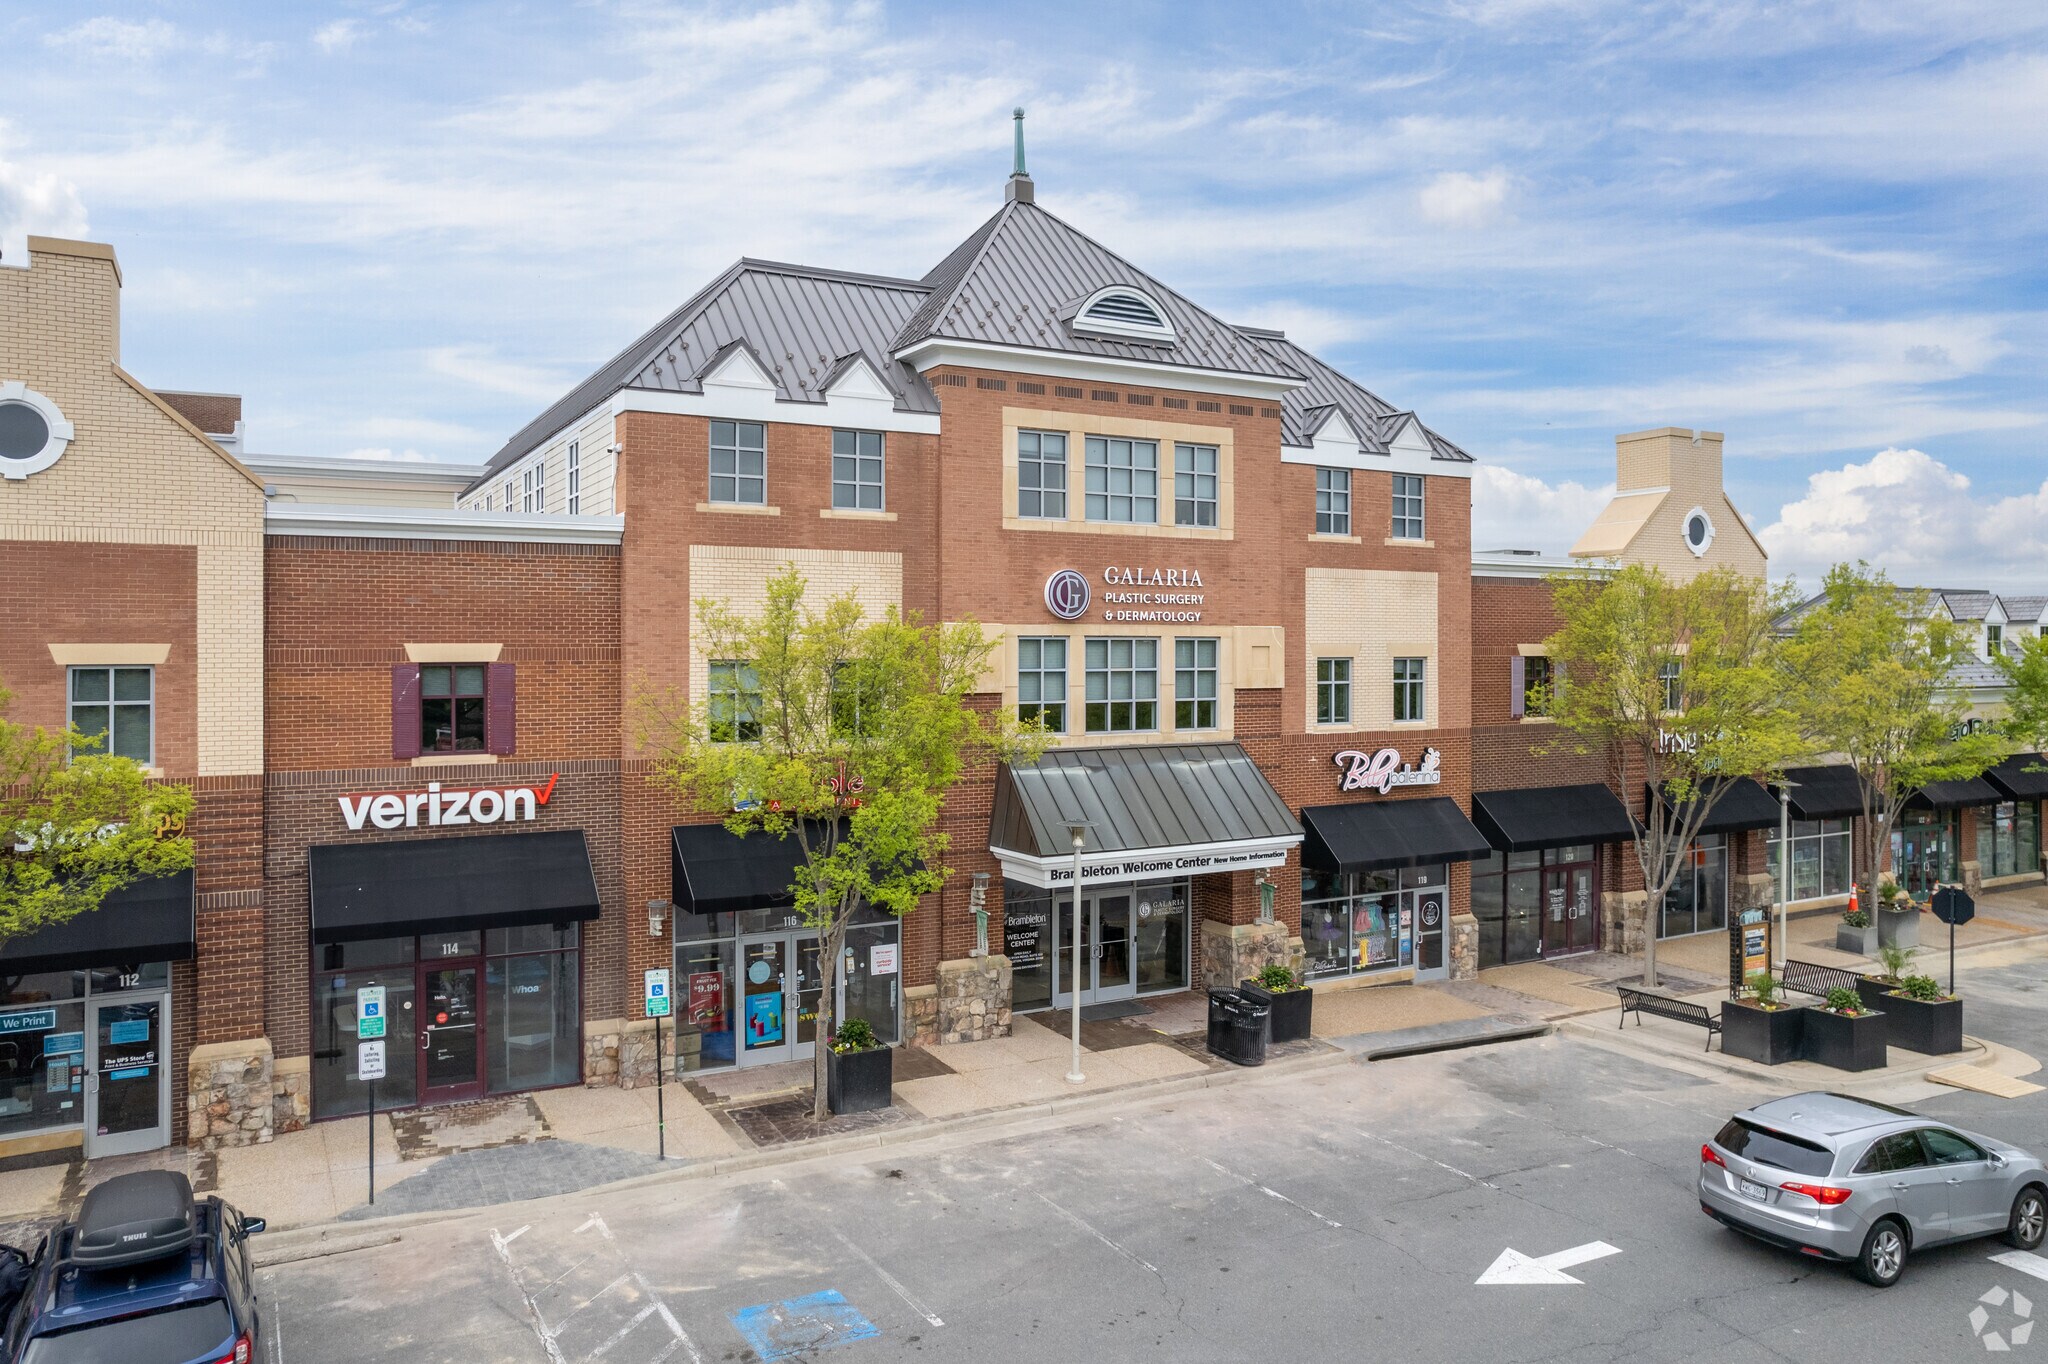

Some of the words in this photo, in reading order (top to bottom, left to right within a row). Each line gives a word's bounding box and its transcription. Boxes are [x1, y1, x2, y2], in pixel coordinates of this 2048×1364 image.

[1104, 566, 1203, 587] GALARIA
[1105, 592, 1151, 604] PLASTIC
[1154, 593, 1204, 605] SURGERY
[1105, 610, 1113, 621] &
[1117, 610, 1201, 622] DERMATOLOGY
[1335, 748, 1400, 794] Bella
[338, 782, 536, 831] verizon
[1123, 861, 1173, 873] Welcome
[1176, 857, 1211, 868] Center
[1249, 851, 1285, 860] Information
[1152, 899, 1185, 908] GALARIA
[783, 916, 797, 927] 116
[1008, 915, 1046, 925] Brambleton
[1007, 931, 1039, 940] WELCOME
[442, 943, 459, 955] 114
[1011, 939, 1035, 947] CENTER
[119, 974, 140, 988] 112
[693, 983, 720, 993] $9.99
[3, 1018, 20, 1029] We
[22, 1016, 46, 1027] Print
